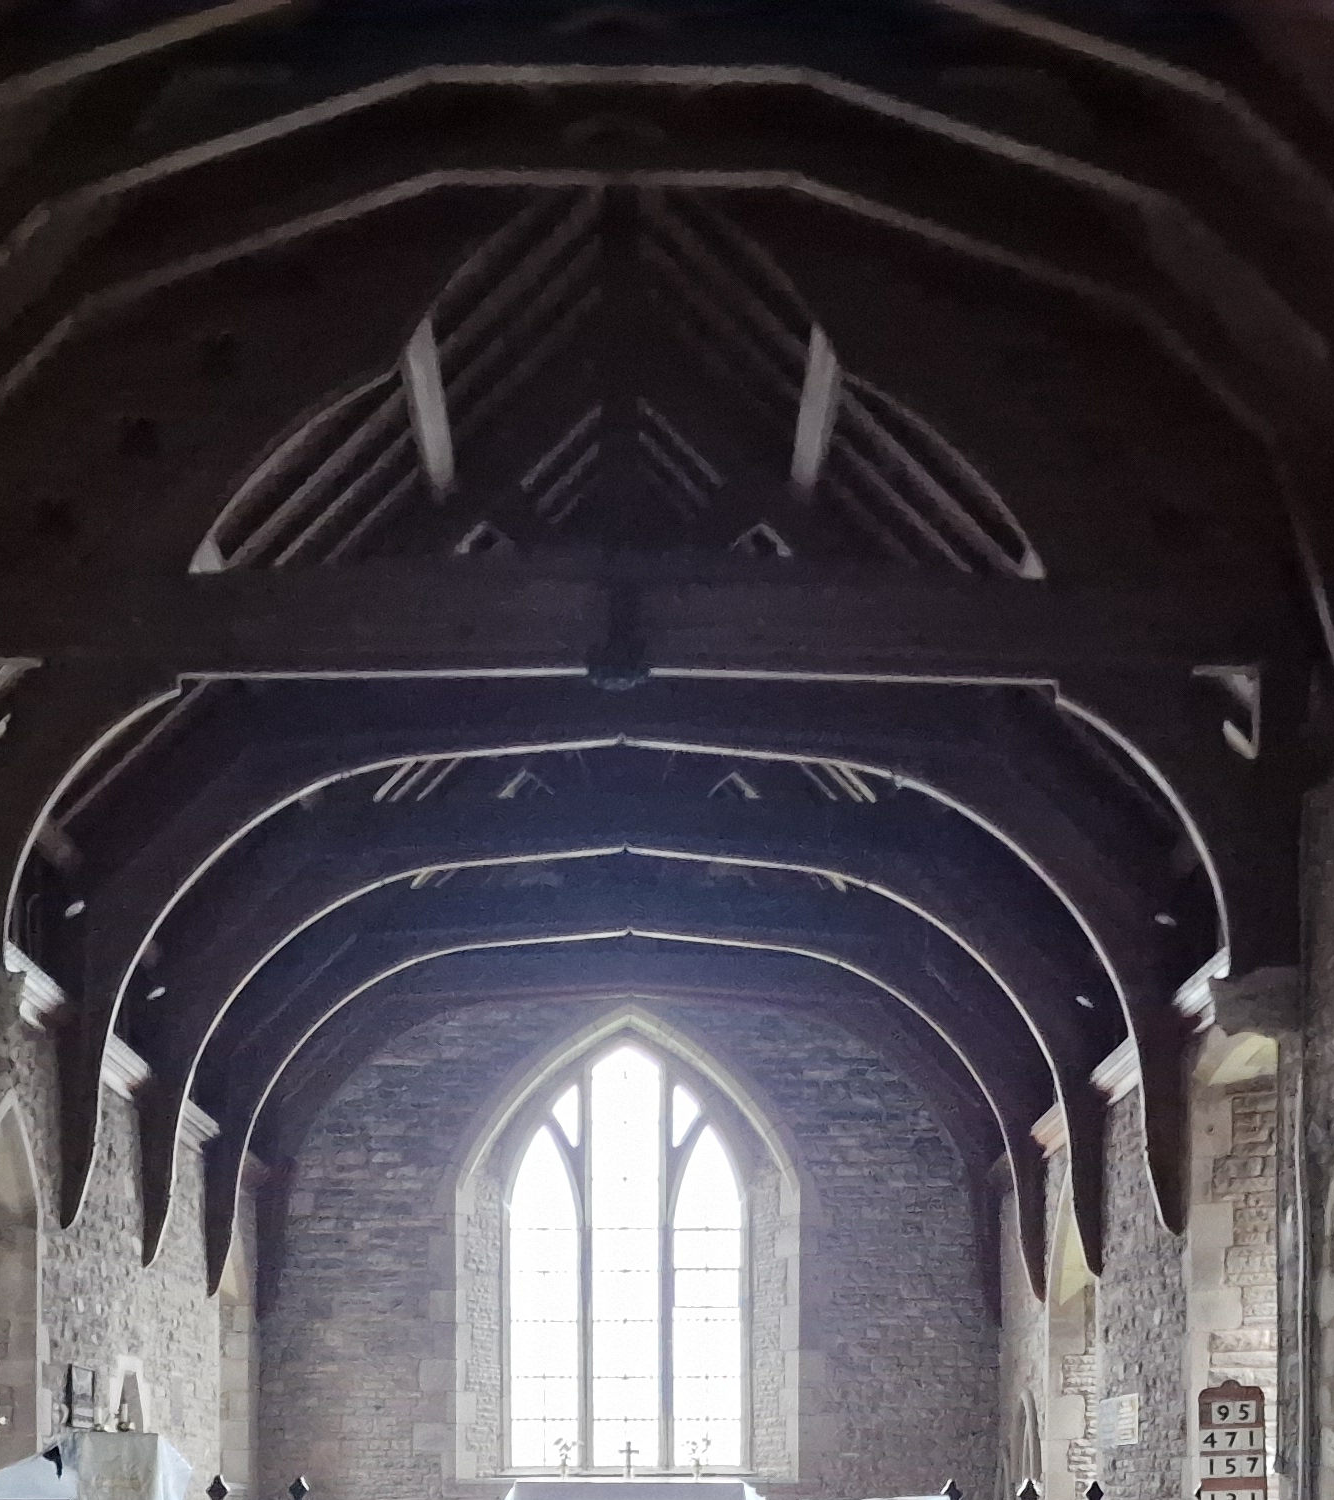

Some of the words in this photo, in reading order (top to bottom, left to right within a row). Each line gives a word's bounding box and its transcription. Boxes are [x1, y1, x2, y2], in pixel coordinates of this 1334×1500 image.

[1216, 1404, 1250, 1421] 95
[1203, 1430, 1254, 1448] 471
[1209, 1457, 1259, 1475] 157
